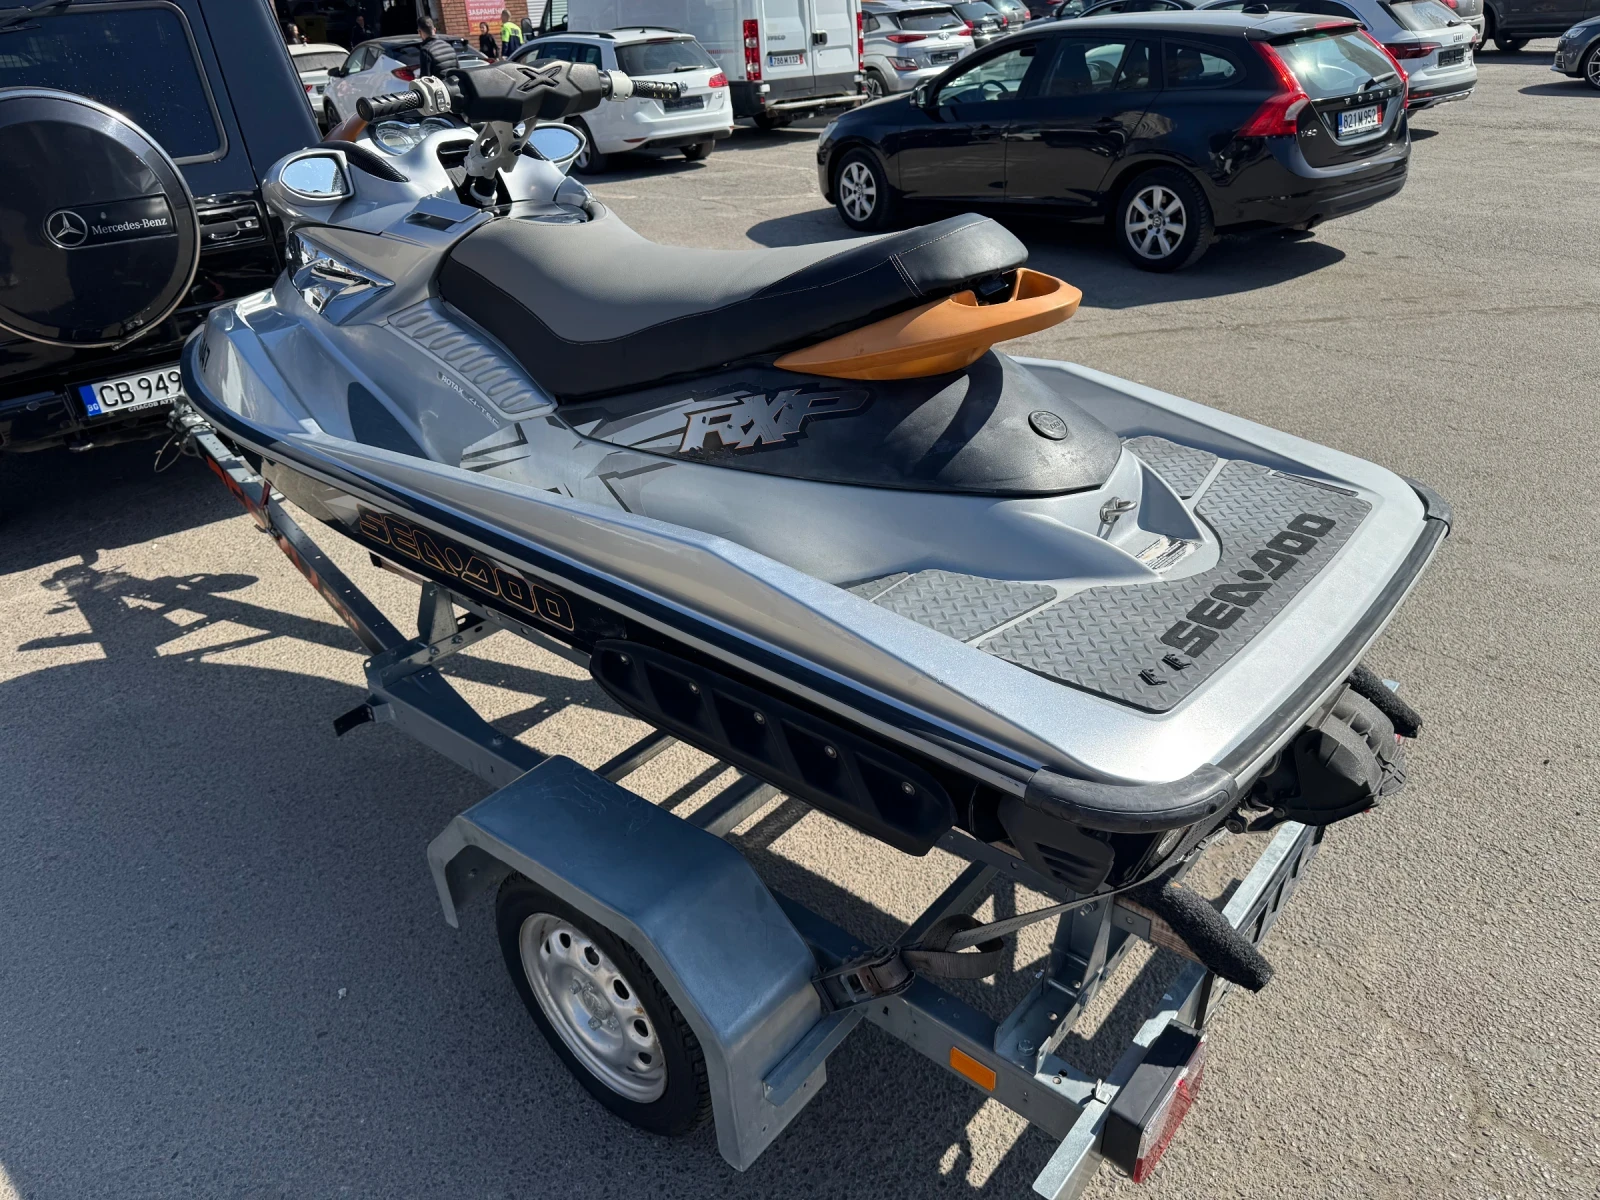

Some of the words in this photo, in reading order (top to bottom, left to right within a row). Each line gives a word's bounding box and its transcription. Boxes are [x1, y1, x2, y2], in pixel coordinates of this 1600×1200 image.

[91, 217, 168, 236] Mercedes-Benz
[99, 381, 136, 407] CB
[441, 374, 464, 395] ROTAX
[88, 403, 100, 412] BG
[128, 401, 159, 412] СПАСОВ
[679, 388, 869, 453] RXP
